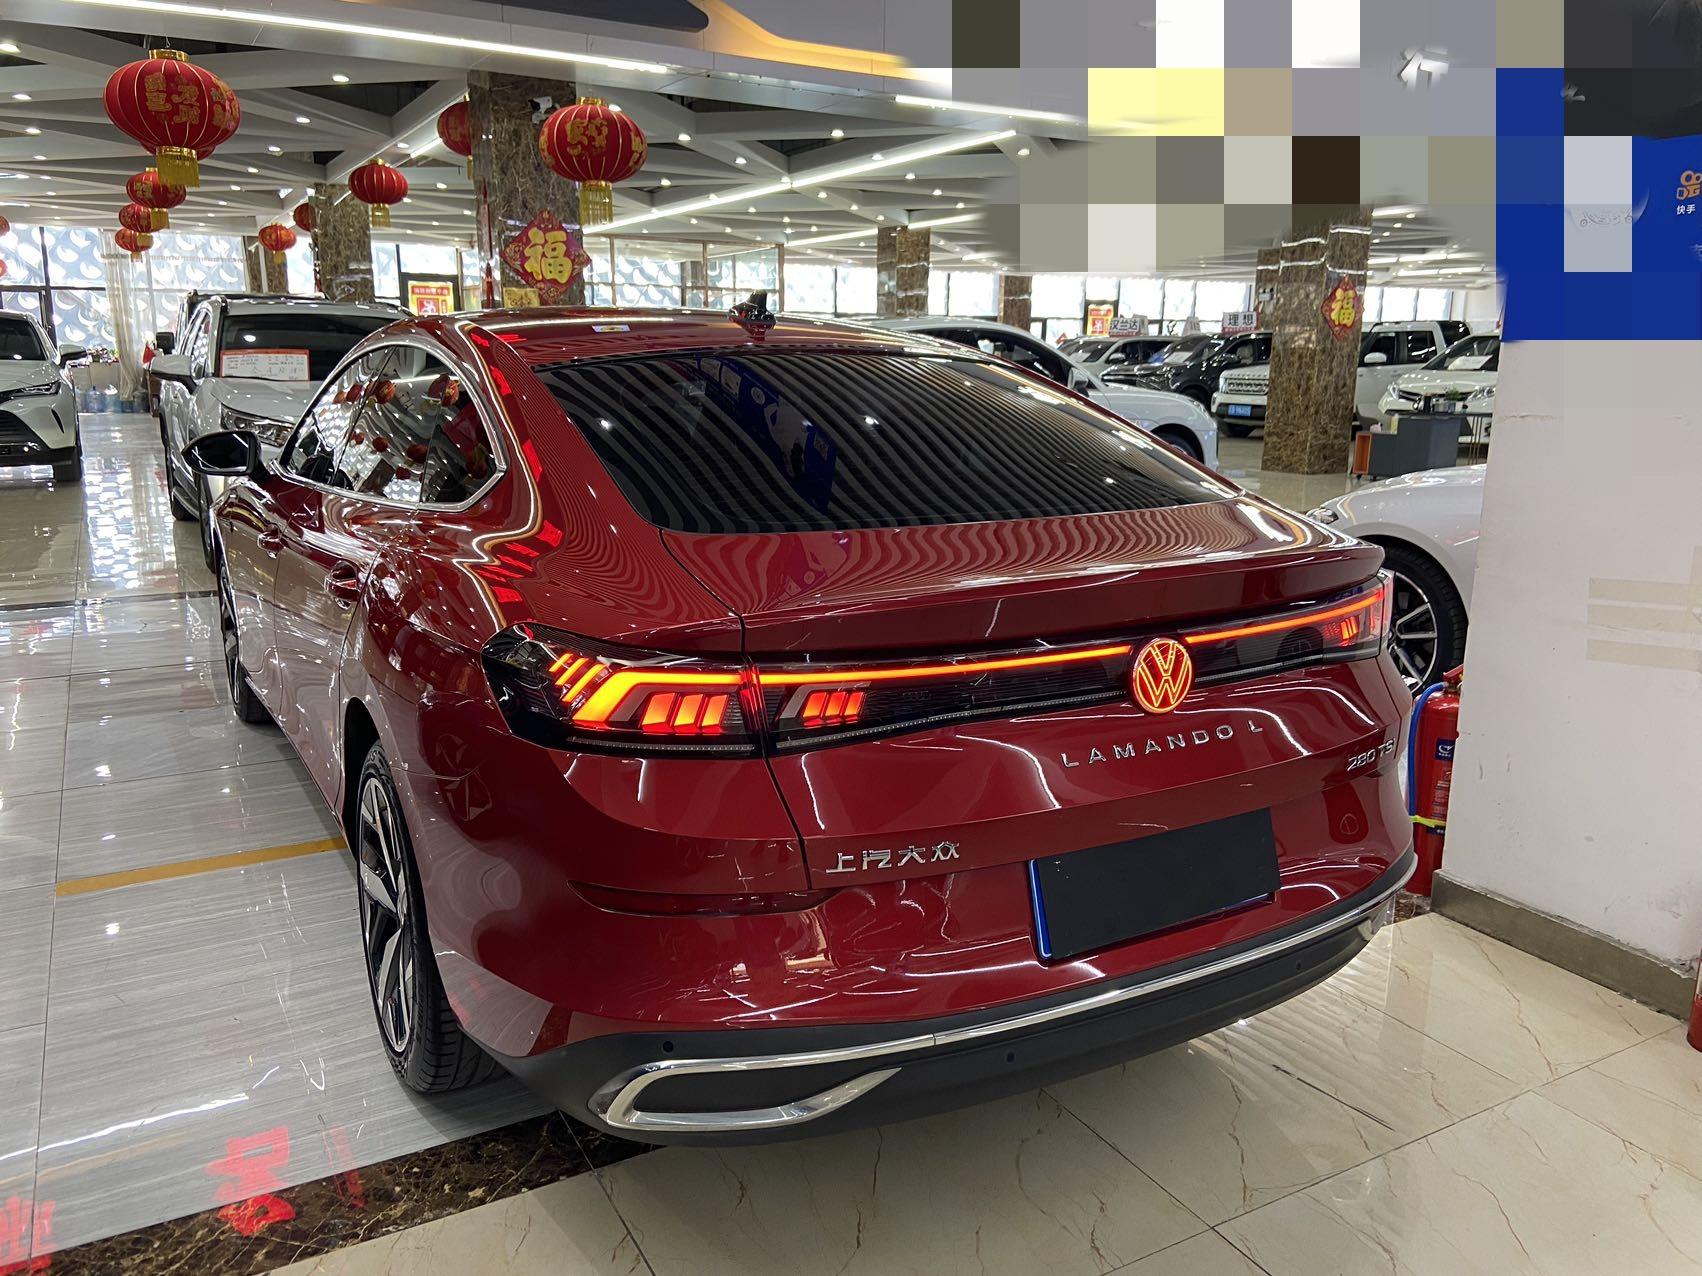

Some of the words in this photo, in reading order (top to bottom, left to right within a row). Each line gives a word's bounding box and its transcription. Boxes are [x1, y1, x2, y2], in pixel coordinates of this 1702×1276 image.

[1676, 204, 1696, 215] 快手
[524, 227, 573, 284] 福
[1228, 313, 1254, 326] 理想
[1331, 288, 1355, 327] 福
[1110, 318, 1138, 330] 汉兰达
[1060, 724, 1234, 768] LAMANDO
[1247, 719, 1263, 733] L
[1347, 749, 1376, 772] 280
[825, 840, 960, 874] 上汽大众
